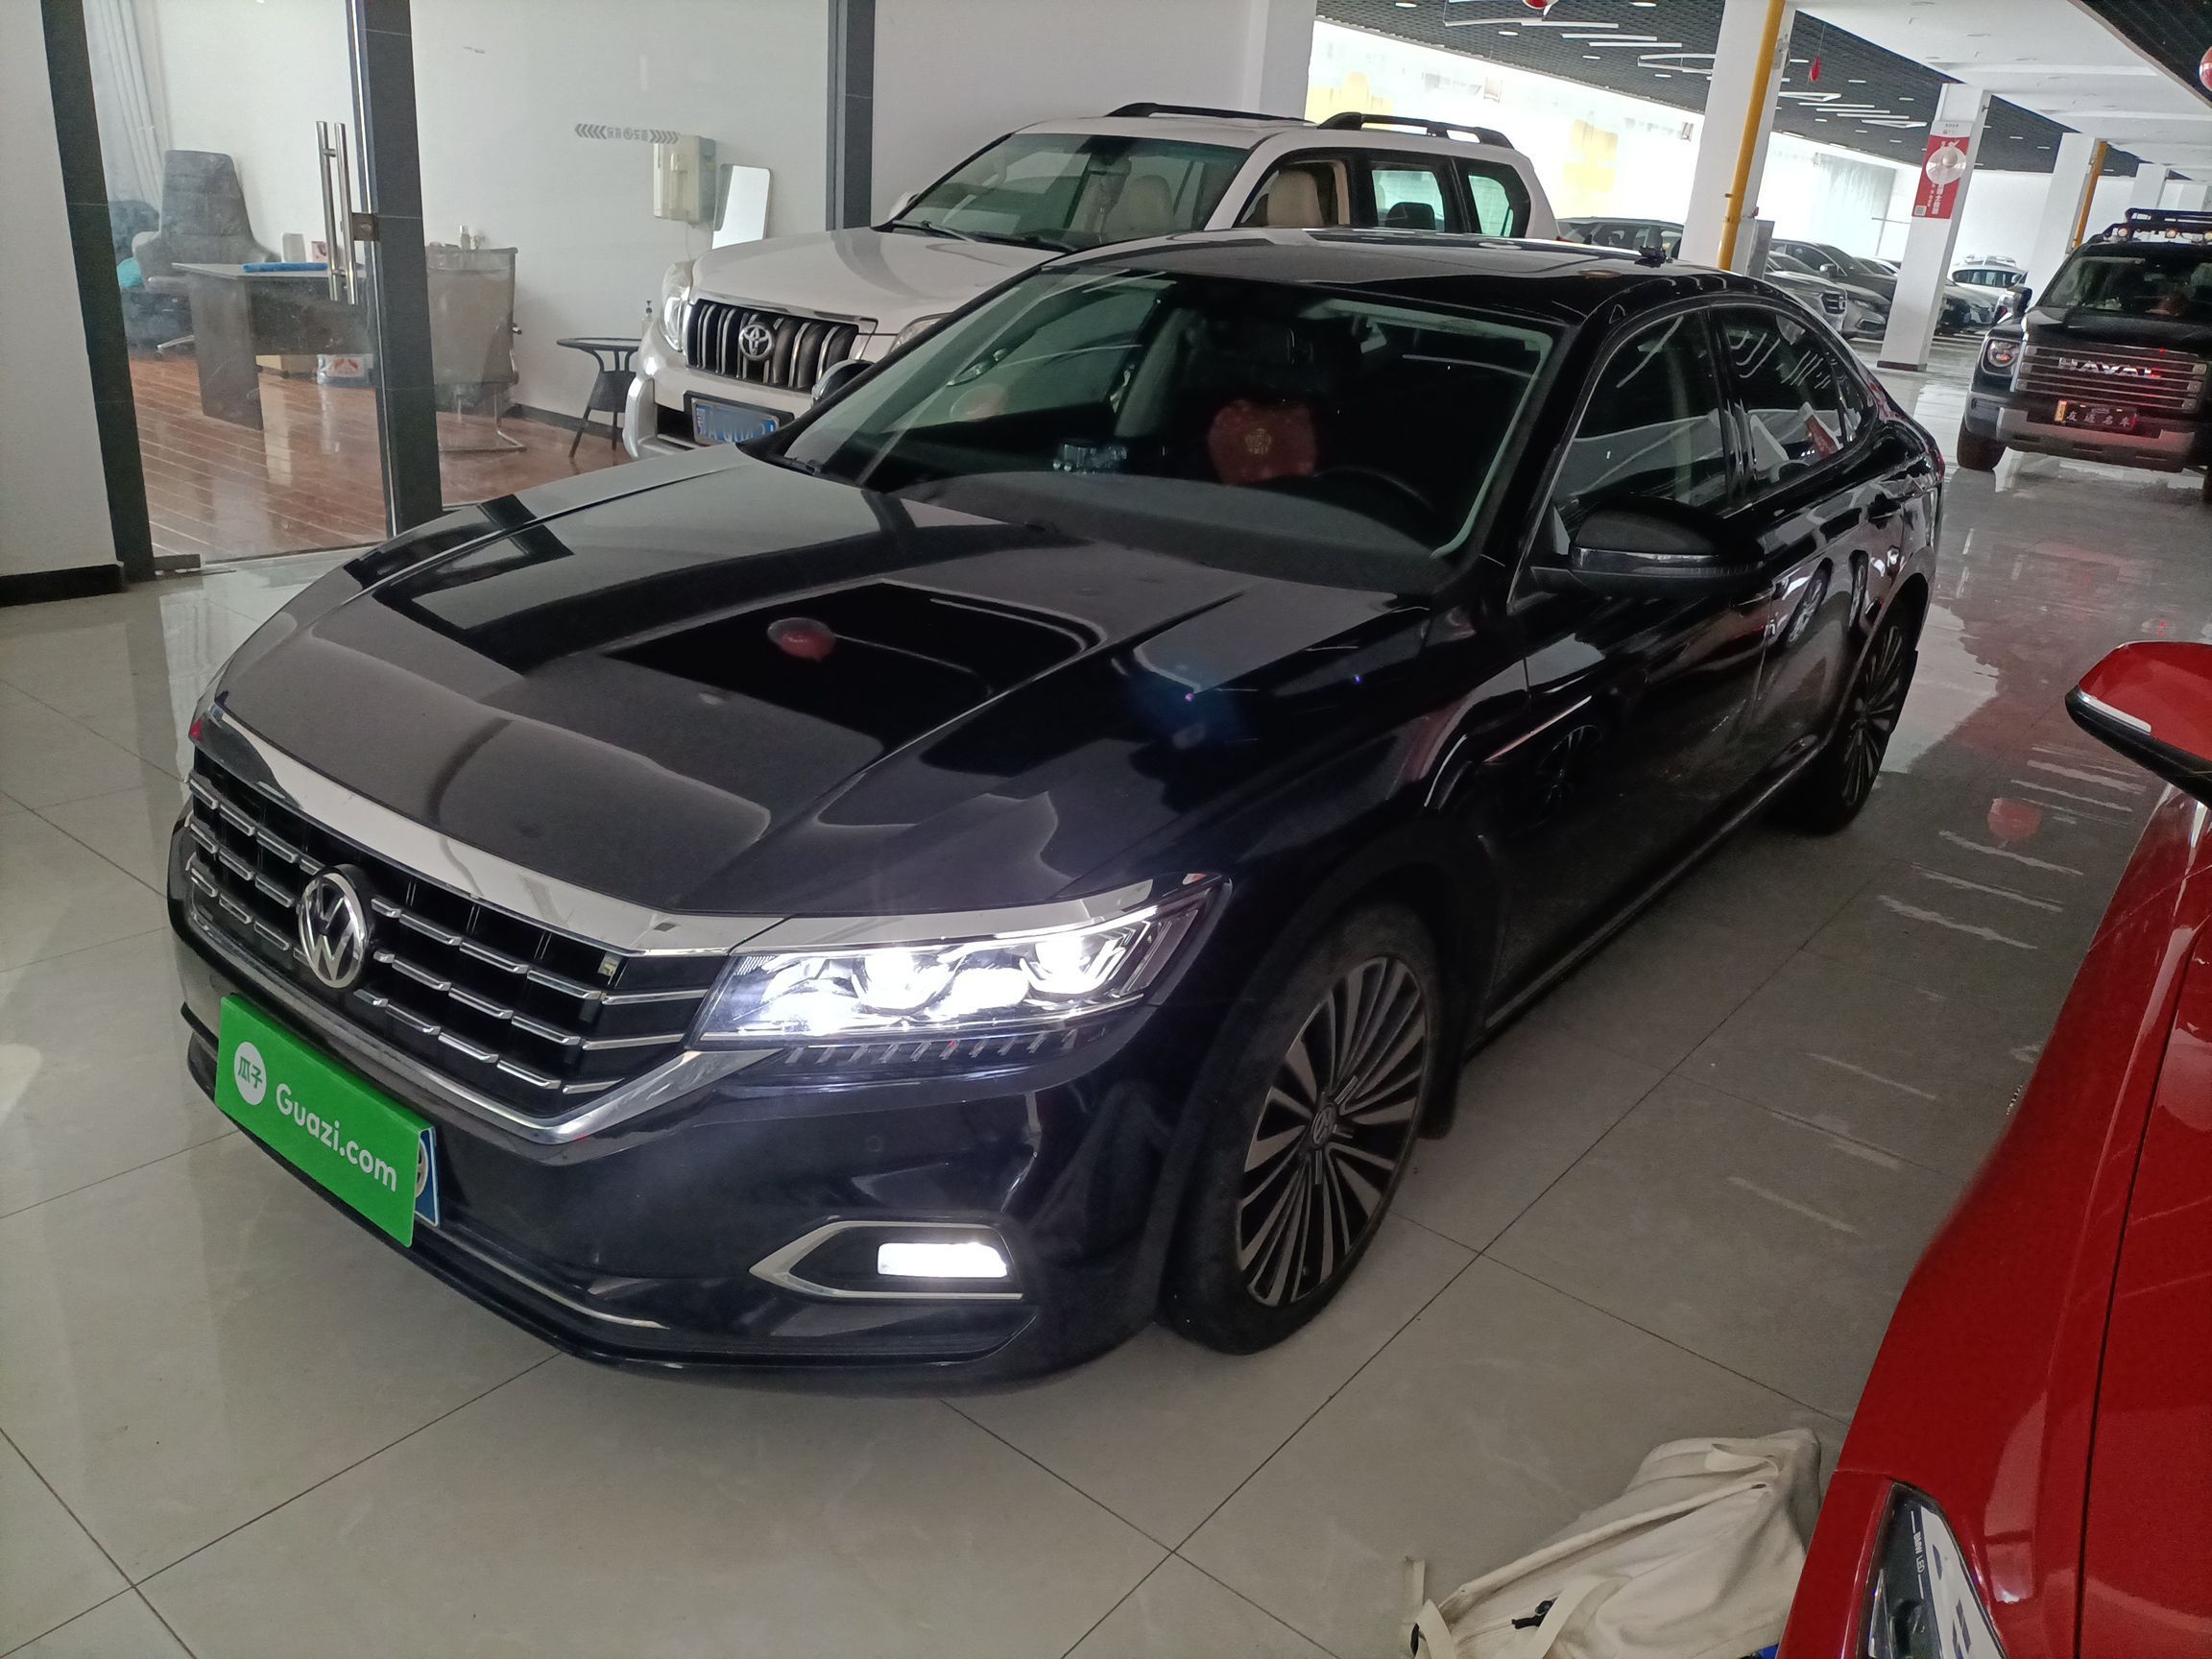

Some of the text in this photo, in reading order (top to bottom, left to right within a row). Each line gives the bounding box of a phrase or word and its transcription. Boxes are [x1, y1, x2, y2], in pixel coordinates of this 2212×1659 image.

[2057, 357, 2162, 378] HAVAL
[238, 1055, 263, 1090] 瓜子
[276, 1082, 397, 1193] Guazi.com
[1913, 1531, 1925, 1573] BMW LED
